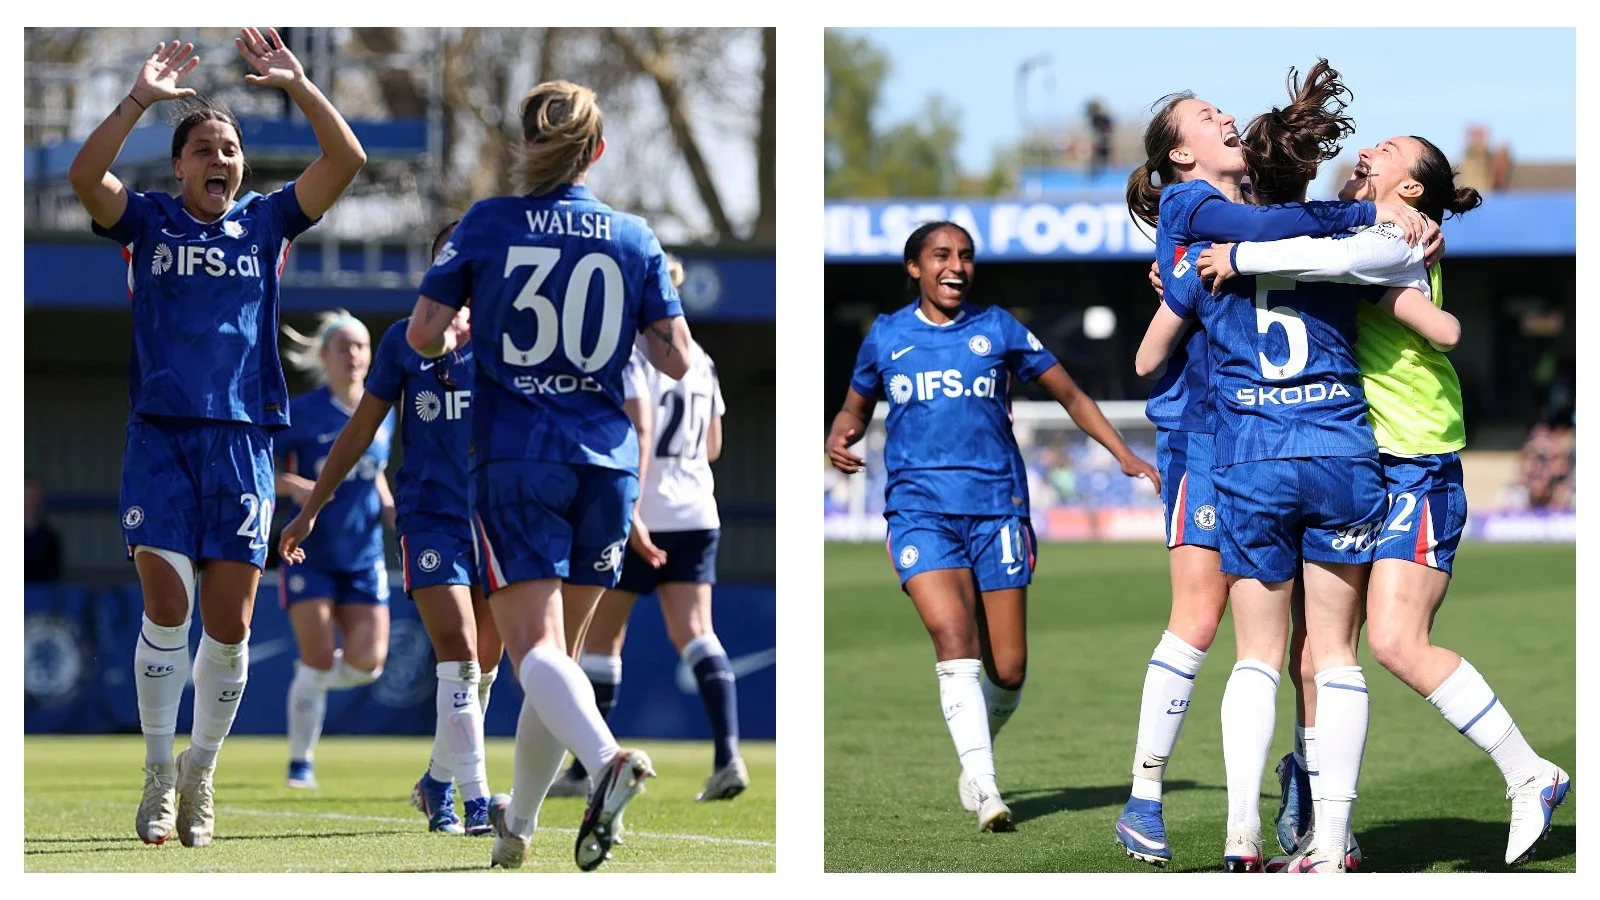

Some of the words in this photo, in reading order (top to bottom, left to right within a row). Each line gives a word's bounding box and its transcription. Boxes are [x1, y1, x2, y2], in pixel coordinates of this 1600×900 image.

[525, 209, 614, 241] WALSH
[177, 244, 261, 278] IFS.ai
[502, 245, 625, 373] 30
[1255, 272, 1309, 380] 5
[915, 367, 997, 401] IFS.ai
[236, 492, 271, 544] 20
